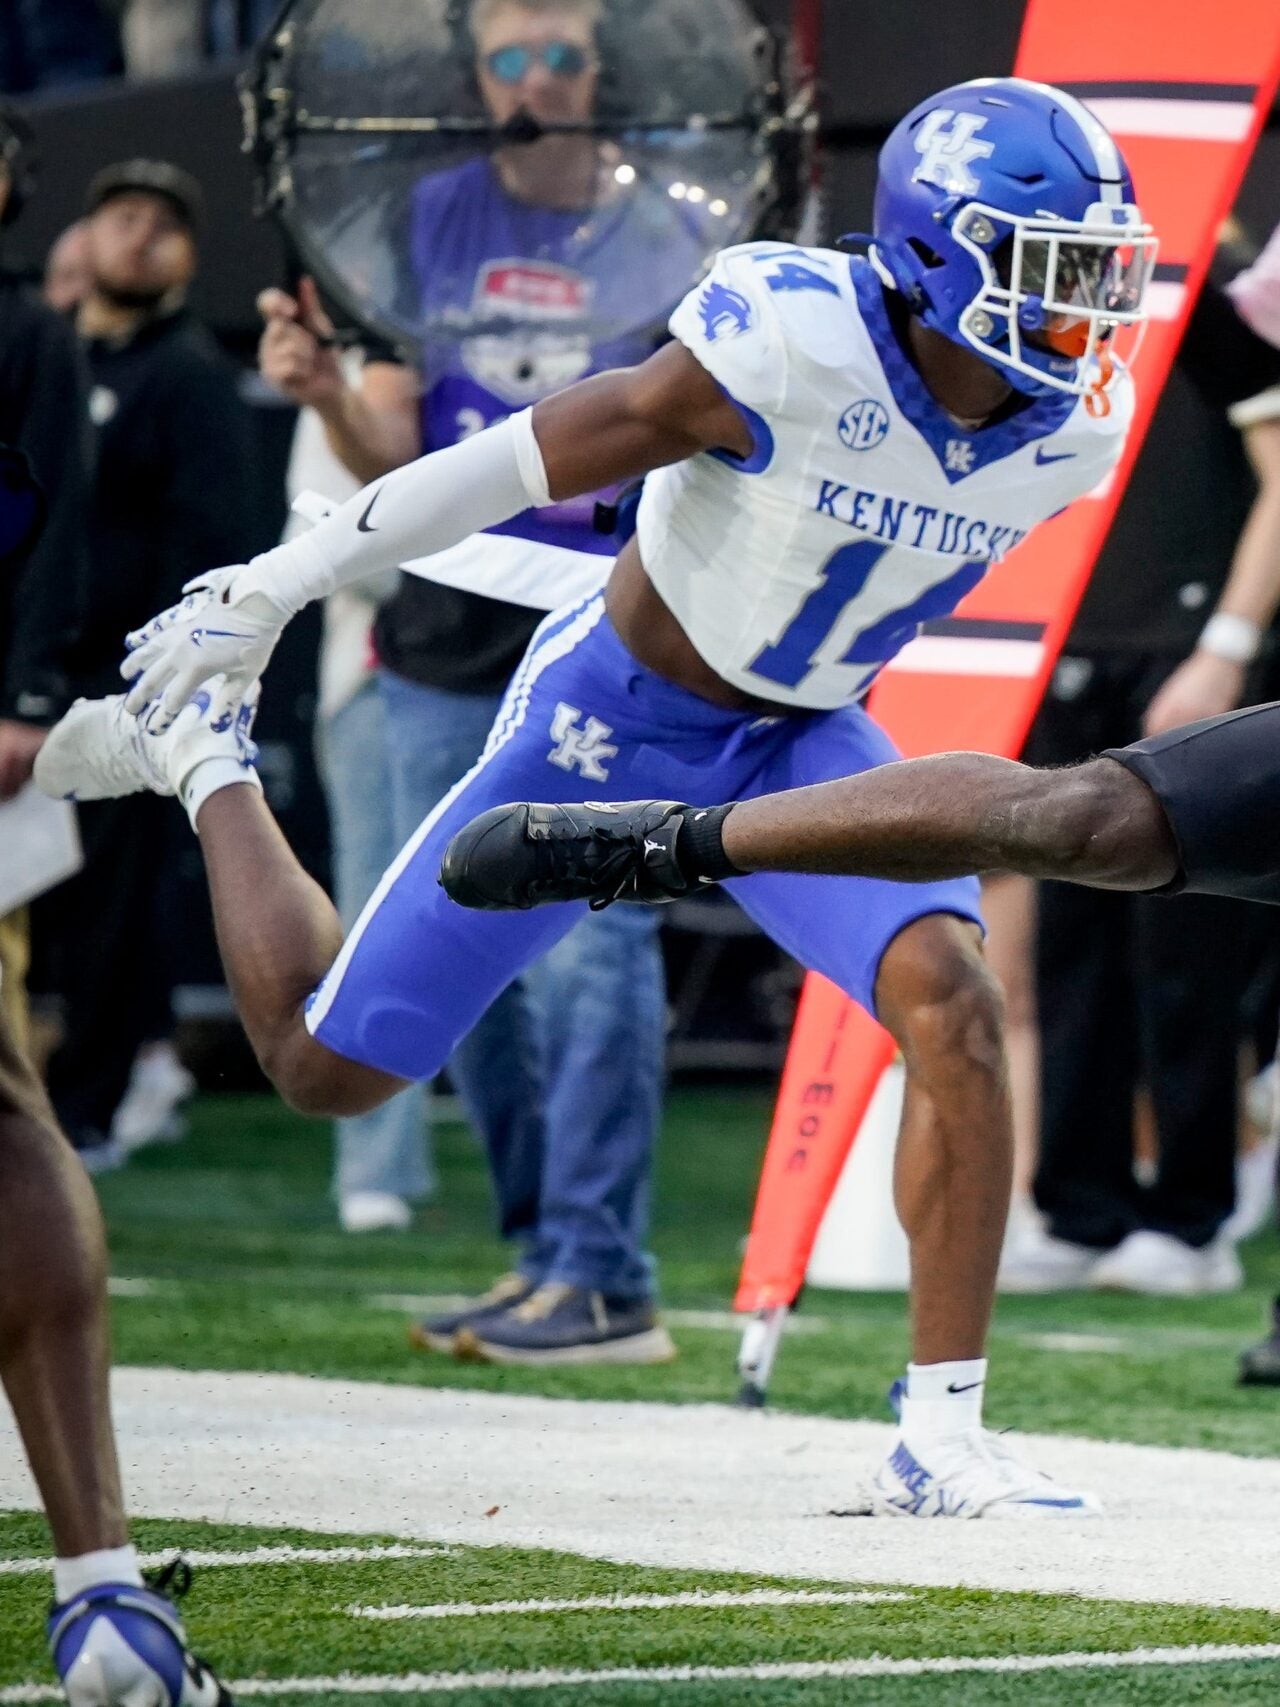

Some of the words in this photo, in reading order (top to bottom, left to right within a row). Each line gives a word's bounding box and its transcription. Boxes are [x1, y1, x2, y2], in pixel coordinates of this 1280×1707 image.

[912, 109, 995, 196] UK
[838, 399, 890, 451] SEC
[546, 701, 619, 783] UK
